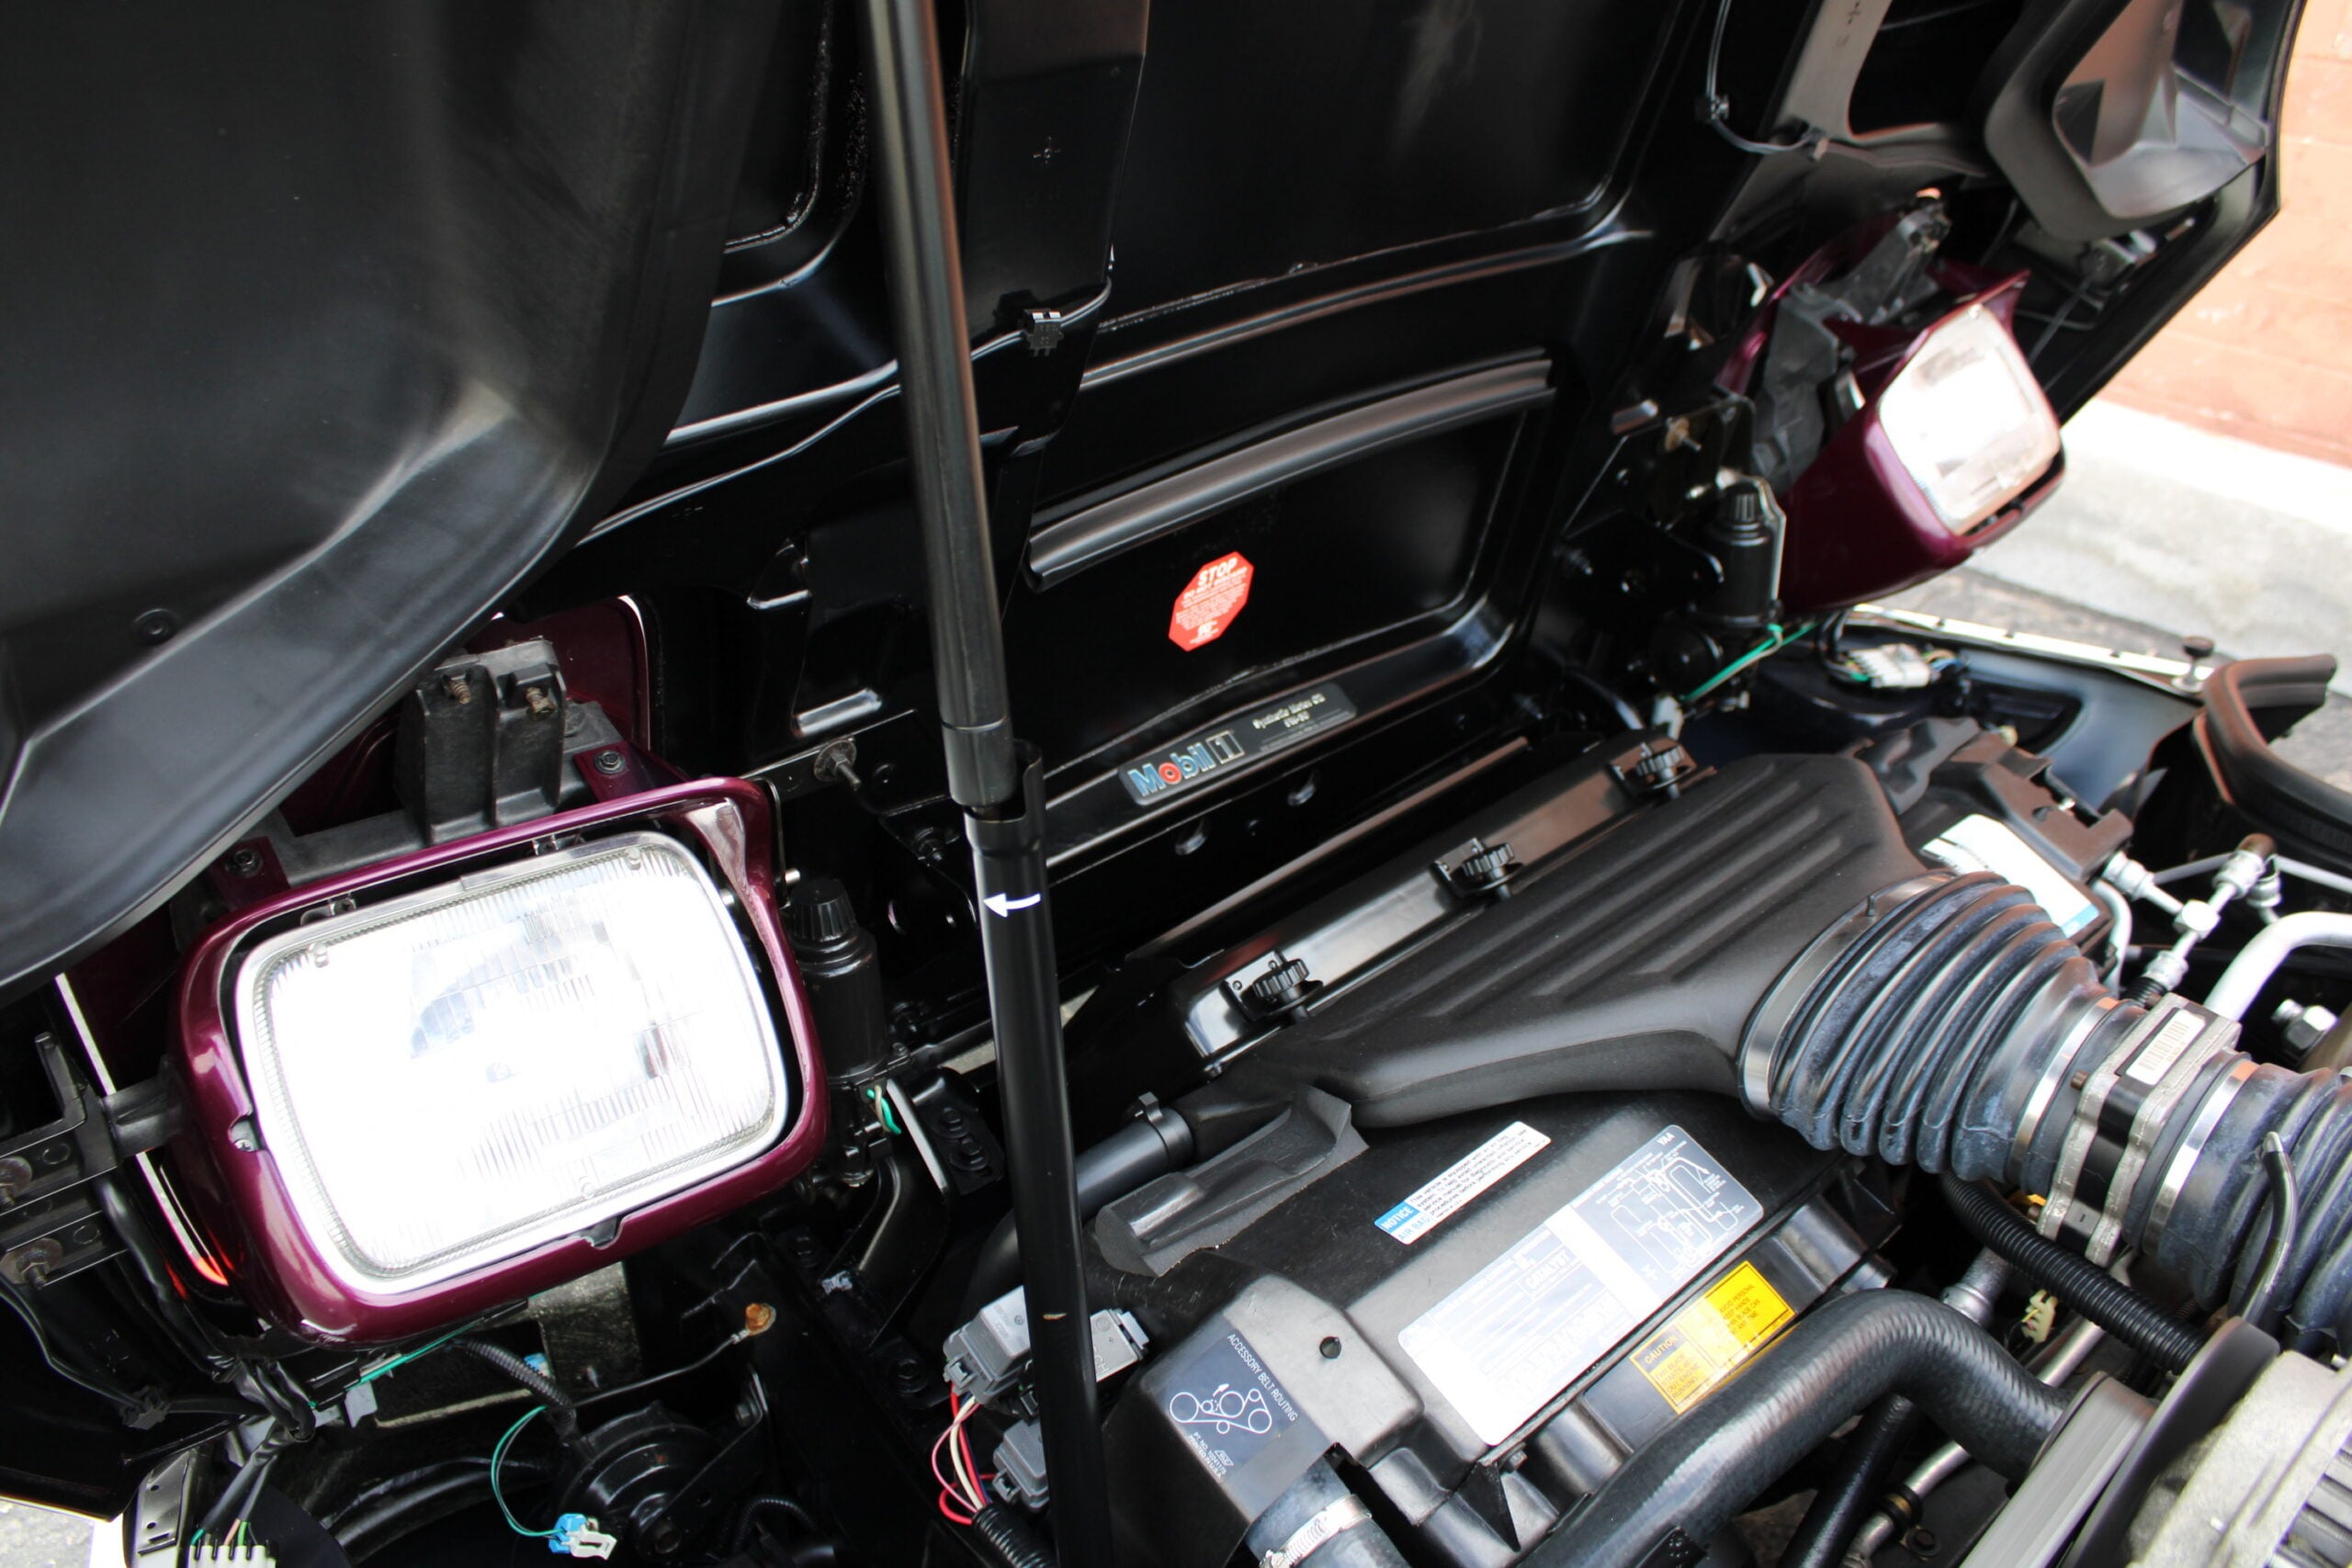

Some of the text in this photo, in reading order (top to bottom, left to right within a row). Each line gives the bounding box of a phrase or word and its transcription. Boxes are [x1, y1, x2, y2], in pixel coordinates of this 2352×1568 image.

[1198, 557, 1238, 586] STOP
[1127, 742, 1216, 796] Mobil
[1657, 1132, 1676, 1145] YAA
[1424, 1181, 1441, 1194] vehicle
[1447, 1160, 1470, 1177] equipped
[1382, 1207, 1412, 1228] NOTICE
[1423, 1197, 1442, 1211] service
[1397, 1217, 1430, 1240] AIR BAG
[1526, 1249, 1571, 1290] CATALYST
[1644, 1333, 1678, 1364] CAUTION
[1227, 1334, 1298, 1421] ACCESSORY BELT ROUTING
